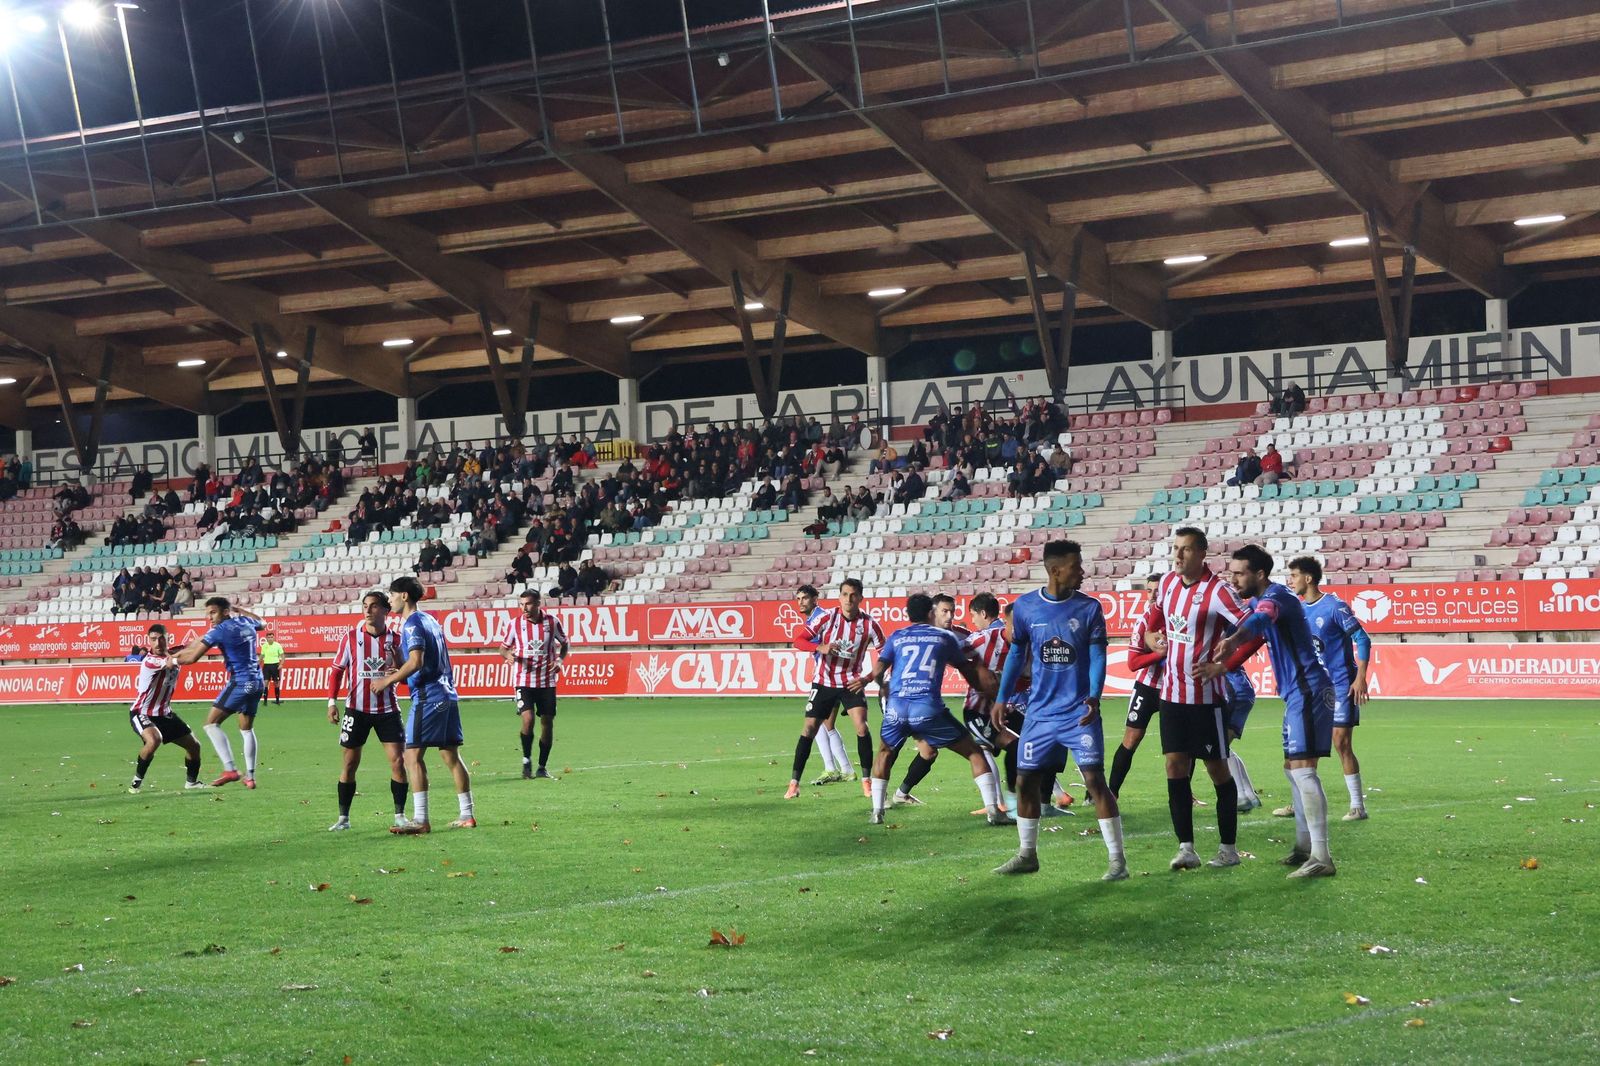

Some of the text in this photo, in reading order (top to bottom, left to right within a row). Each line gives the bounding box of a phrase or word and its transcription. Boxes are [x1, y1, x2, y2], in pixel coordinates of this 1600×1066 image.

[228, 420, 457, 474] MUNICPAL
[1393, 587, 1516, 598] ORTOPEDIA
[1392, 600, 1519, 616] tres cruces
[546, 606, 639, 643] URAL
[653, 608, 745, 638] AMAQ
[29, 640, 68, 654] sangregorio
[71, 639, 111, 653] sangregorio
[1043, 646, 1070, 654] Estrella
[901, 645, 937, 679] 24
[1467, 658, 1600, 675] VALDERADUEY
[195, 671, 230, 684] VERSU
[561, 663, 615, 678] VERSUS
[671, 652, 759, 692] CAJA
[36, 677, 65, 695] Chef
[92, 675, 132, 691] INNOVA
[565, 678, 609, 686] E-LEARNING
[1479, 677, 1509, 685] CENTRO
[1512, 677, 1556, 685] COMERCIAL
[1133, 696, 1143, 711] 5
